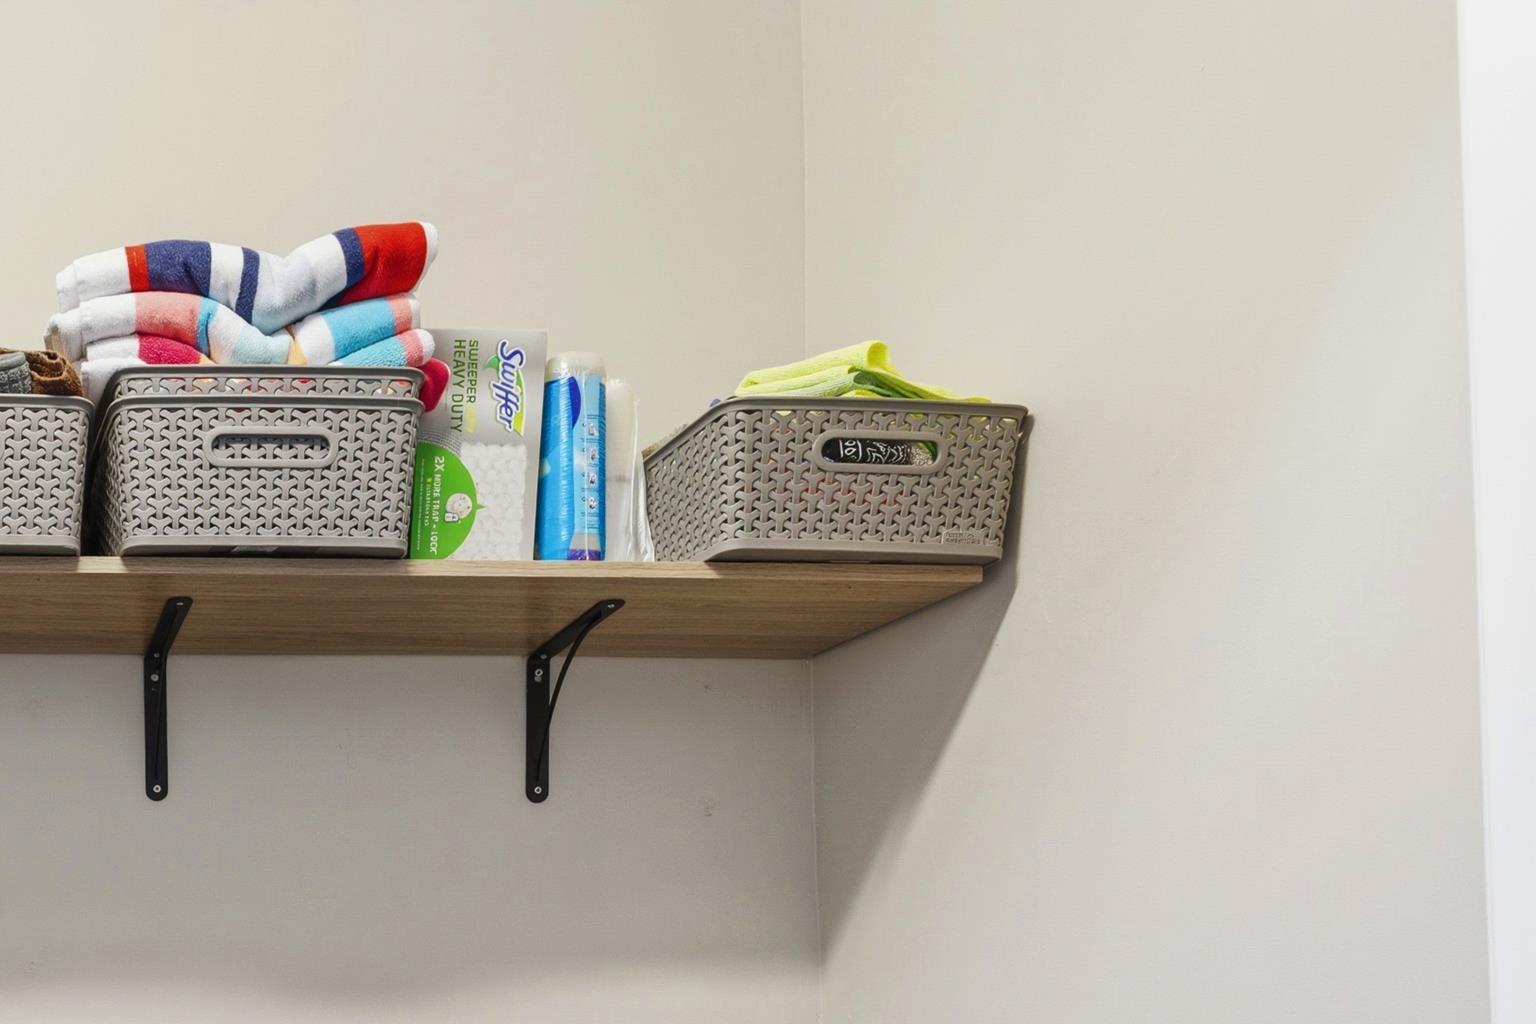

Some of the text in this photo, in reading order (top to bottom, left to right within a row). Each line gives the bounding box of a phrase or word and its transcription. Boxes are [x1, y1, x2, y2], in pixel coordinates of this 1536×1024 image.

[450, 339, 467, 433] HEAVY DUTY
[467, 339, 479, 404] SWEEPER
[492, 340, 524, 430] Swiffer
[434, 455, 445, 471] 2X
